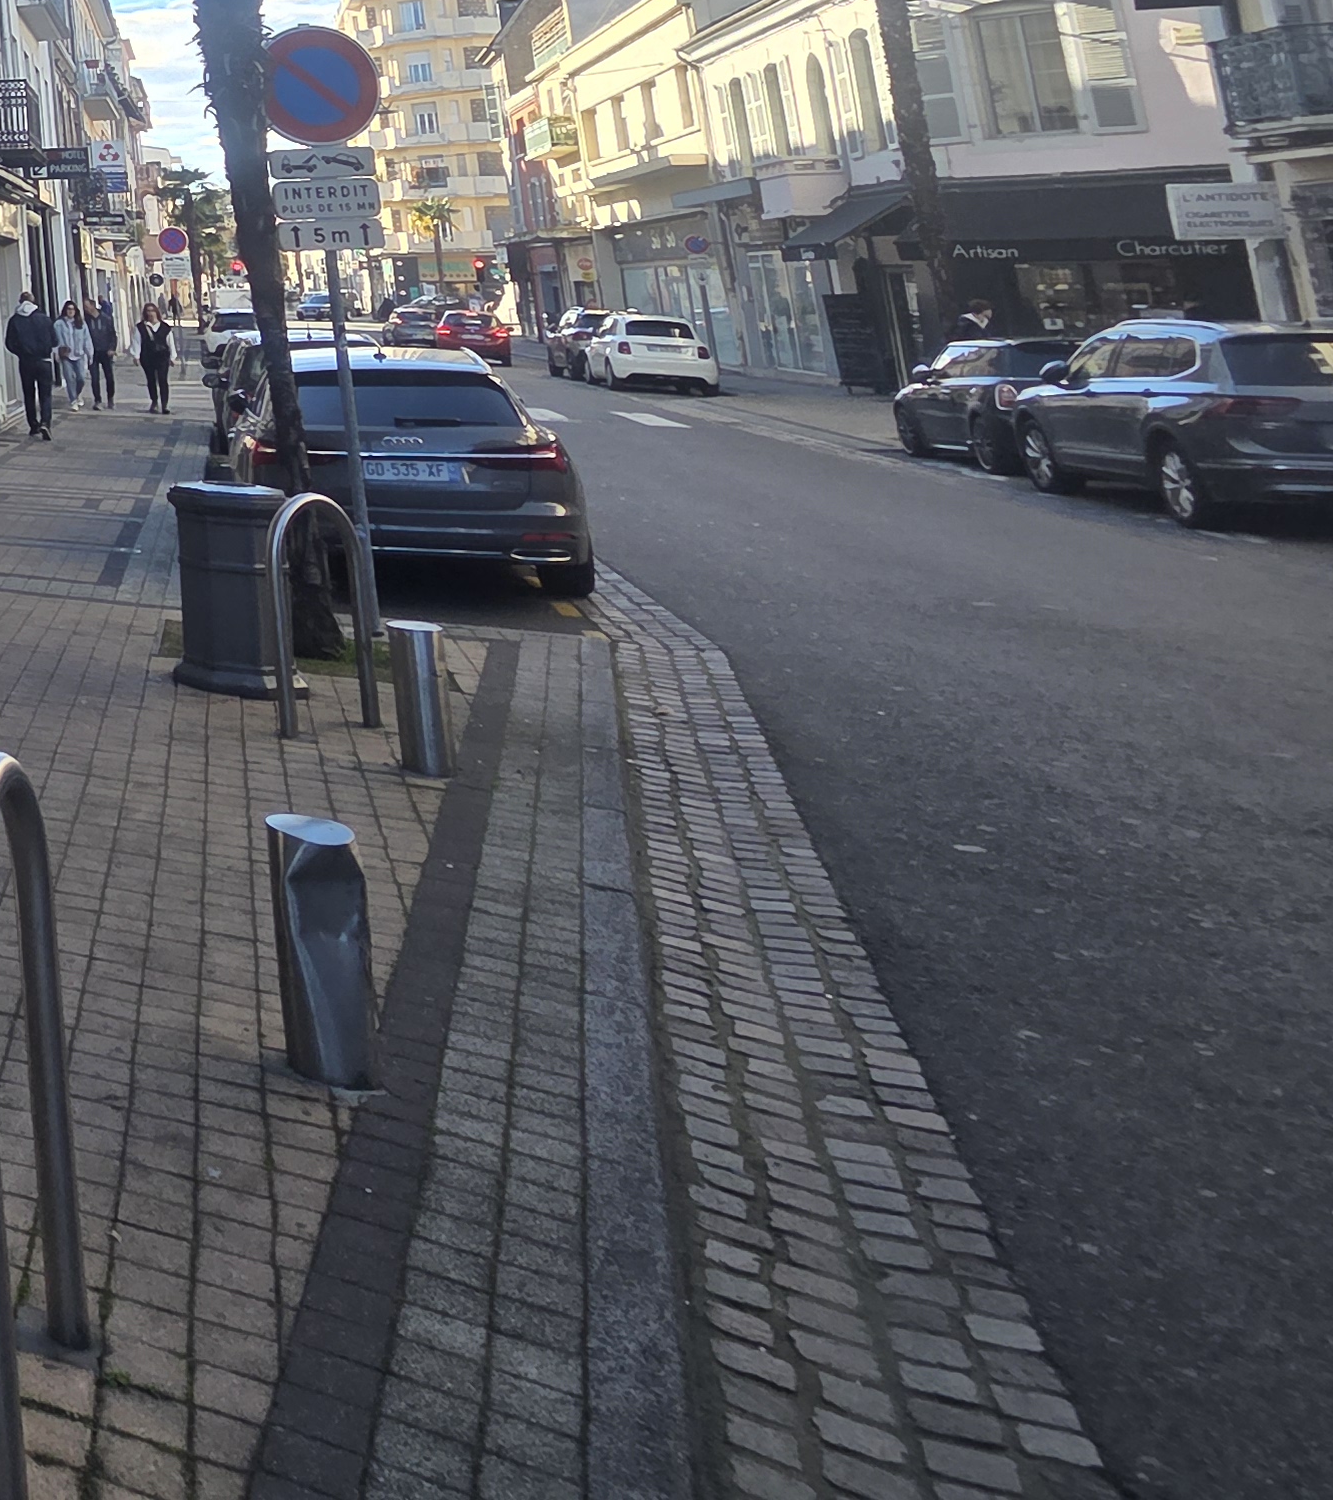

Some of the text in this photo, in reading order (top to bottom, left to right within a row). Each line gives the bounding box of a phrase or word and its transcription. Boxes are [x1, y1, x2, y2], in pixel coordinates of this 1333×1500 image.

[50, 164, 87, 174] PARKING
[283, 184, 369, 200] INTERDIT
[281, 201, 376, 214] PLUS DE 15 MN
[313, 227, 350, 244] 5 m
[952, 239, 1229, 259] Artisan Charcutier
[366, 462, 444, 478] GD-535-XF
